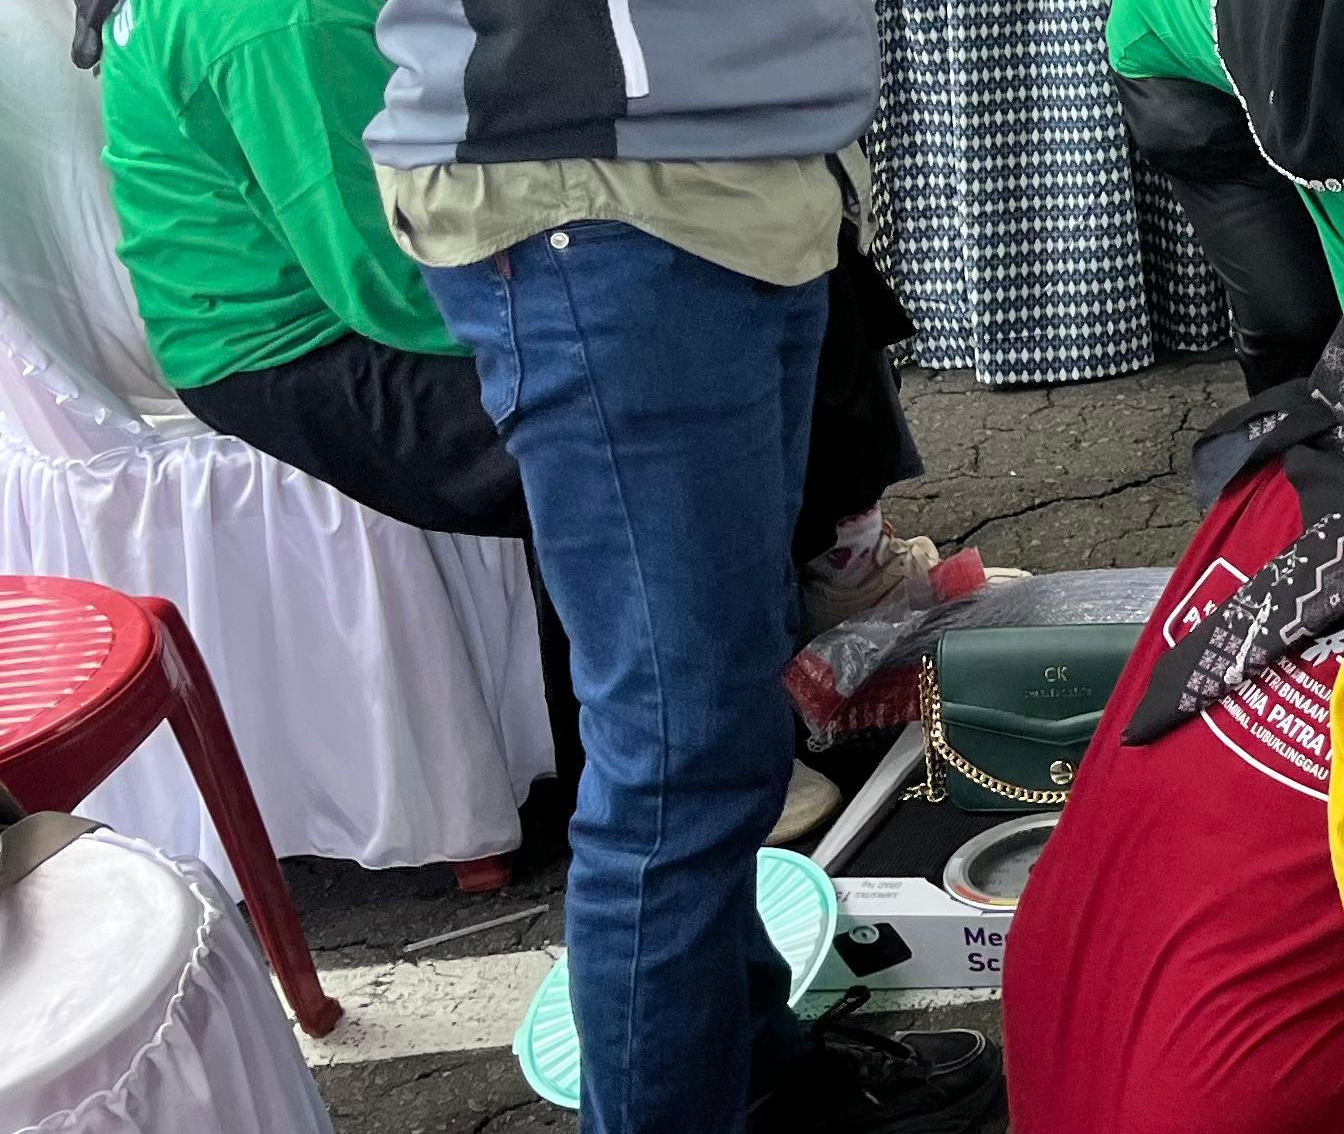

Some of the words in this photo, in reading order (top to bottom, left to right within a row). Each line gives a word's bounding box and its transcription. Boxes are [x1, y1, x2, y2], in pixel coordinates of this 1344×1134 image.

[1044, 666, 1068, 683] CK
[1278, 682, 1330, 724] BINAAN
[1265, 702, 1326, 756] PATRA
[1249, 720, 1329, 781] LUBUKLINGGAU
[963, 926, 1007, 947] Me
[967, 952, 1001, 972] Sc
